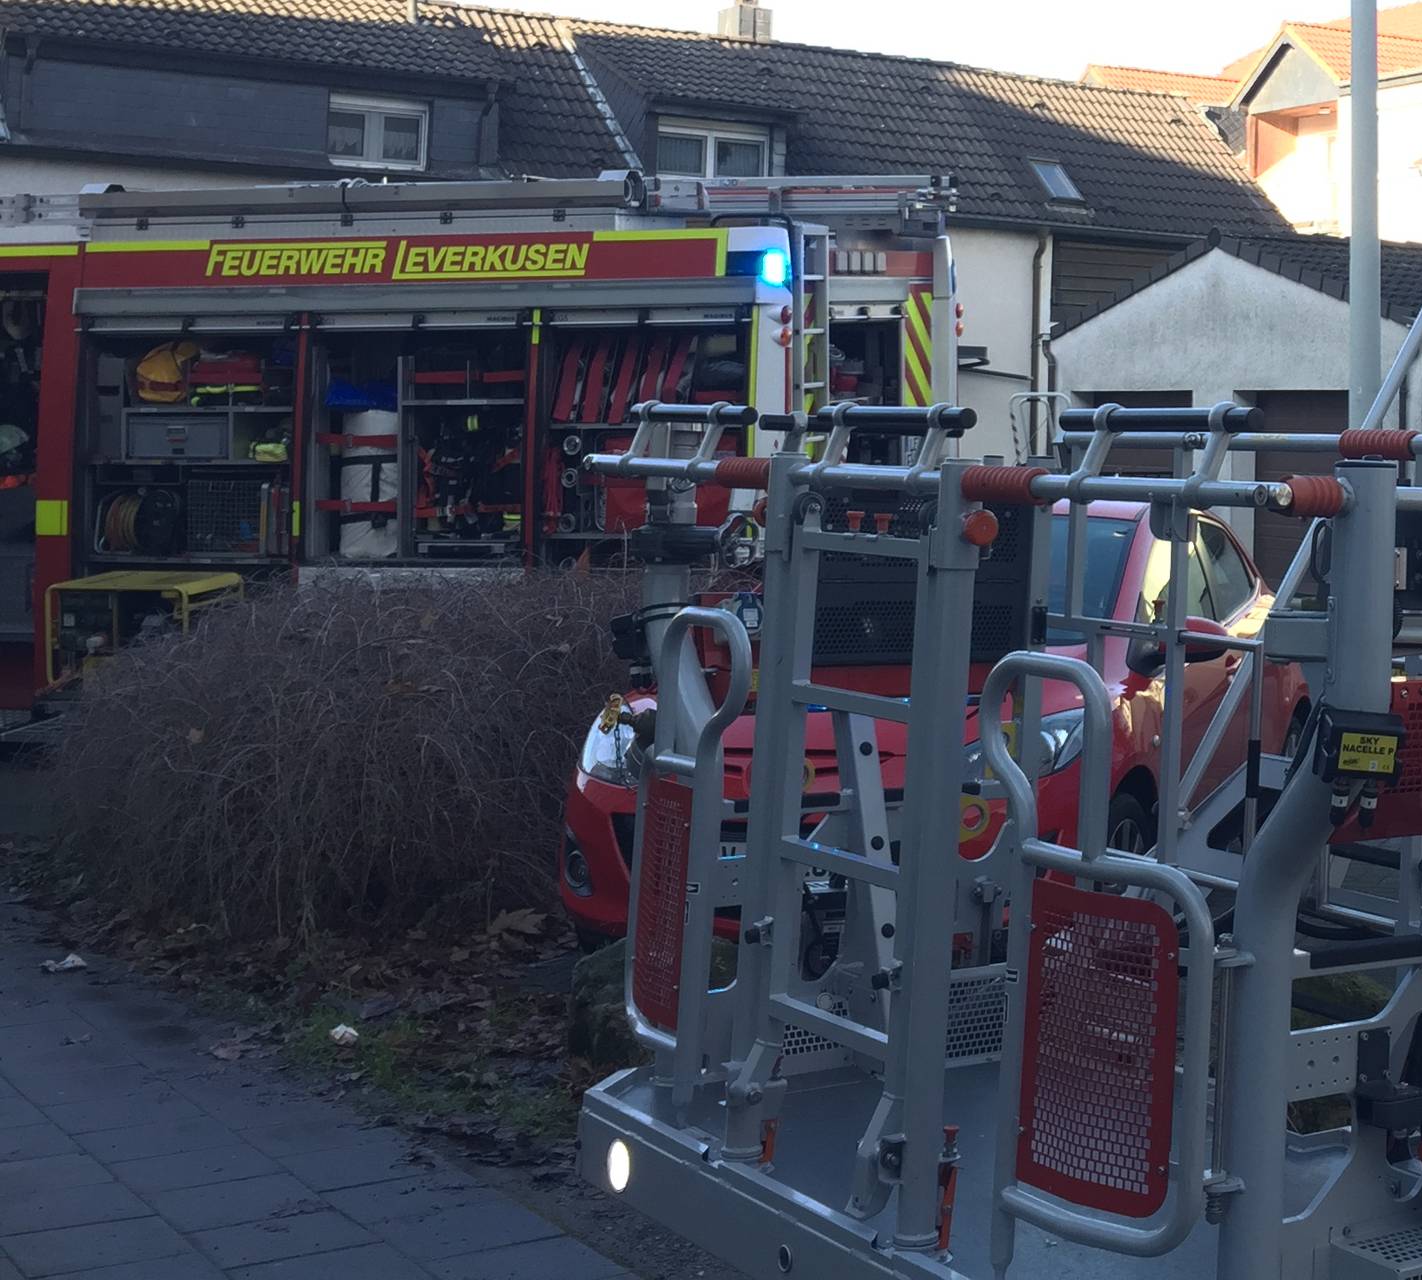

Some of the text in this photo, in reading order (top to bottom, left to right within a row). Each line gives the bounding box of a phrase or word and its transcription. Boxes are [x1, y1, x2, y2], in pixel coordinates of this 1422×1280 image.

[205, 239, 590, 280] FEUERWEHR LEVERKUSEN
[1361, 736, 1379, 745] SKY
[1342, 744, 1385, 755] NACELLE
